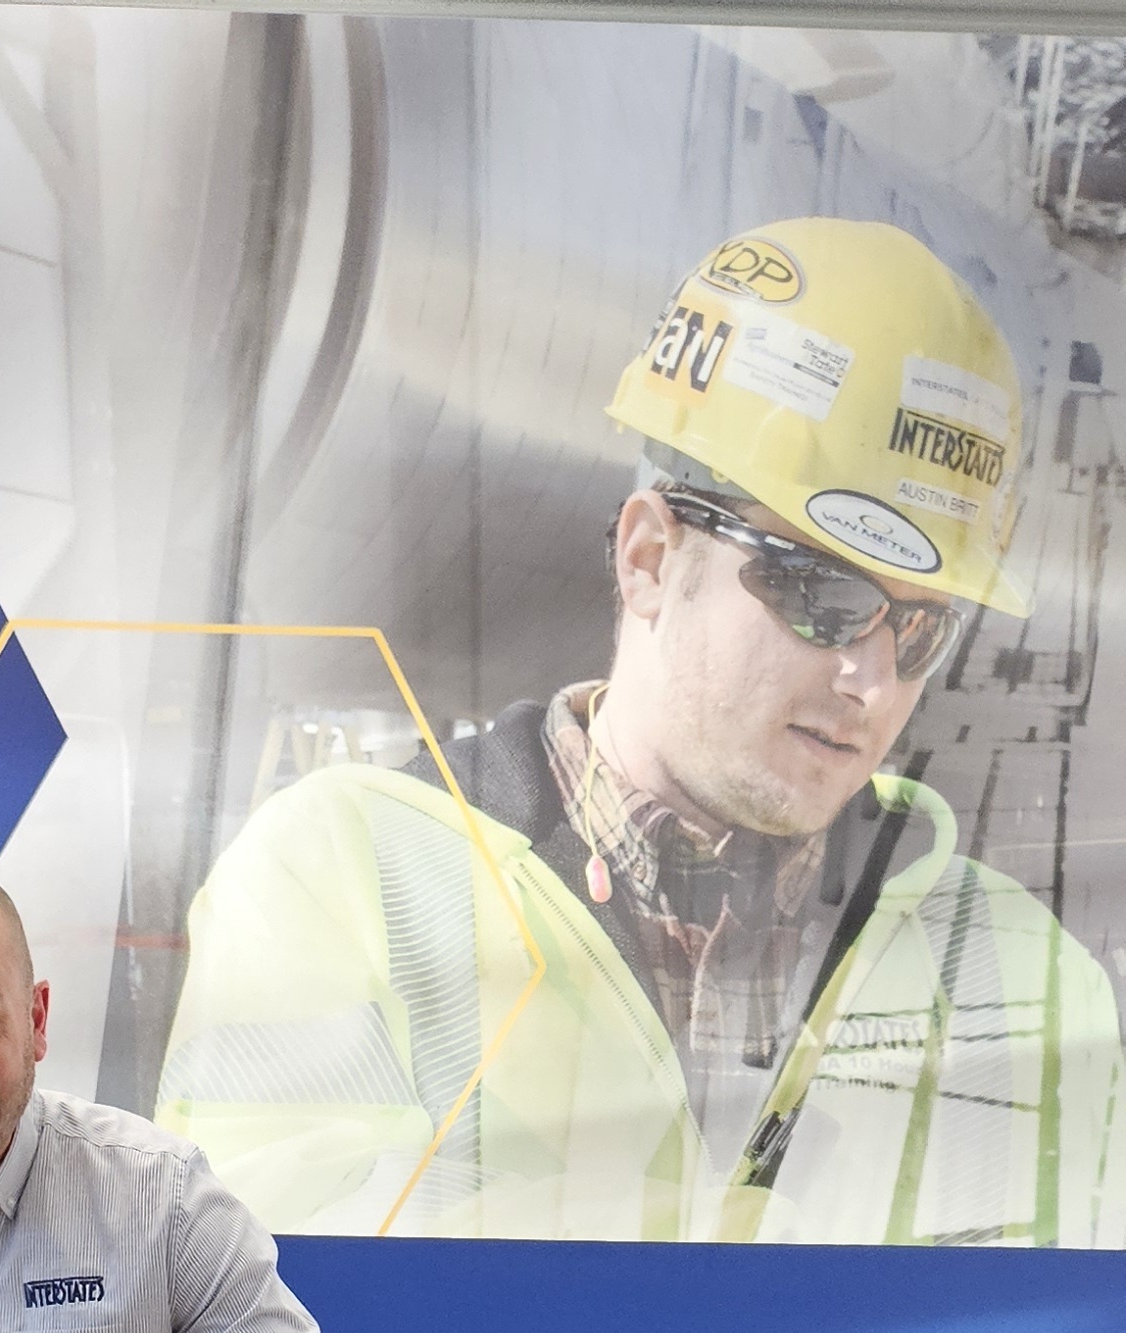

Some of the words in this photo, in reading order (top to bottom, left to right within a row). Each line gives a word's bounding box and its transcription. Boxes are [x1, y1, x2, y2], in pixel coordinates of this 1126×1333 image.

[888, 406, 1006, 487] INTERSTATES
[898, 482, 949, 509] AUSTIN
[822, 511, 858, 531] VAN
[861, 527, 922, 563] METER
[24, 1276, 105, 1308] INTERSTATES
